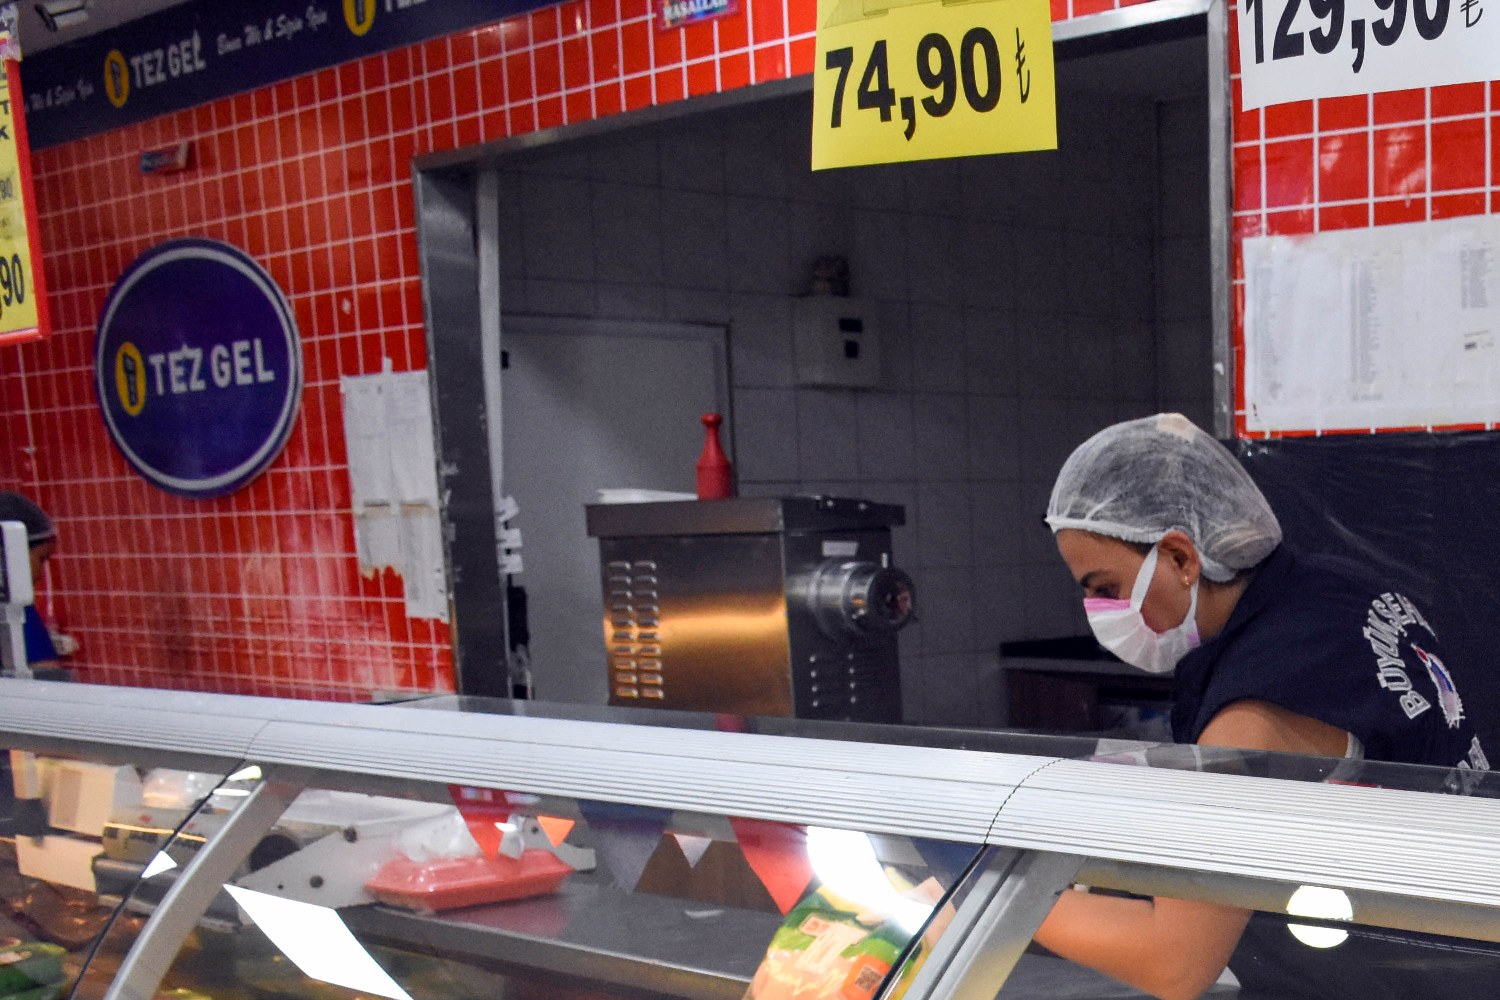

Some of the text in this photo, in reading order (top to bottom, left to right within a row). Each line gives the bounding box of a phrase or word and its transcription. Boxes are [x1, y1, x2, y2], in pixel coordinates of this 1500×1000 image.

[130, 31, 206, 89] TEZ GEL
[826, 27, 1001, 141] 74,90
[149, 337, 276, 396] TEZ GEL
